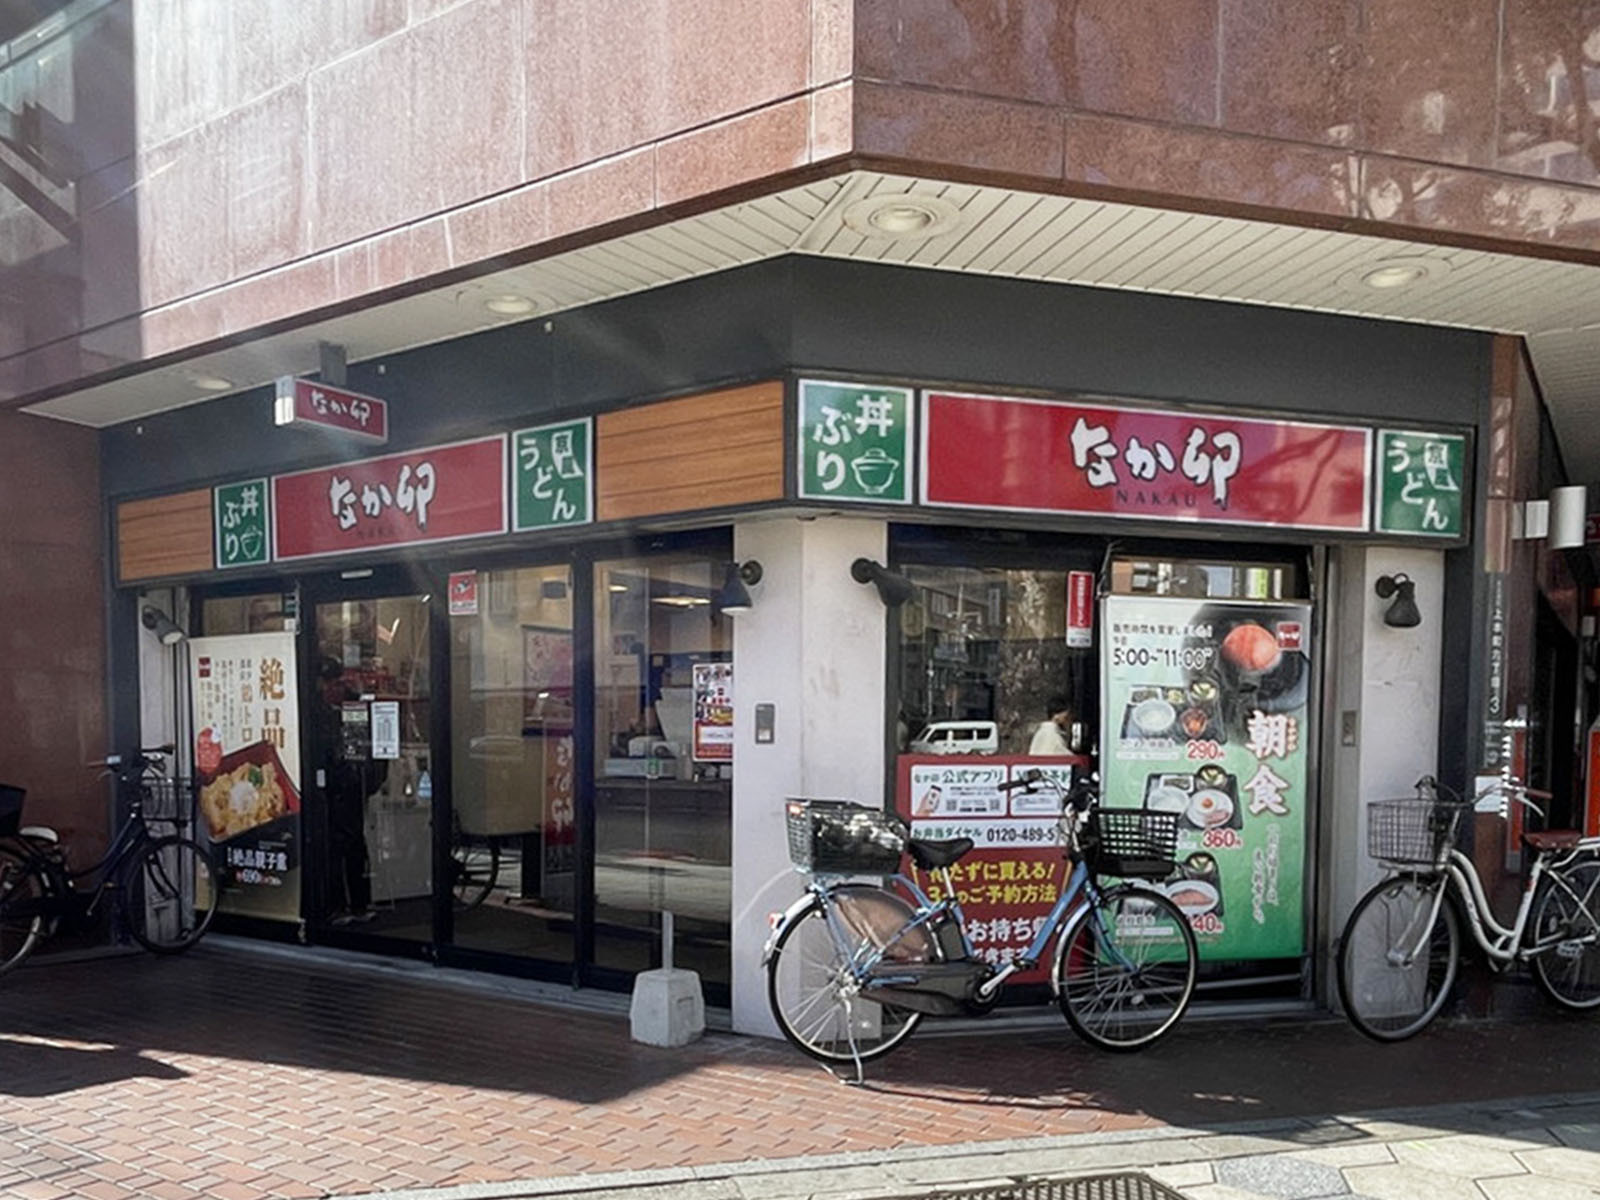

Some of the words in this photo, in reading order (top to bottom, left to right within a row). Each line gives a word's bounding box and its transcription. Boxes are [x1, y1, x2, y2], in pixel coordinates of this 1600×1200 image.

[310, 388, 371, 427] なか卯
[329, 461, 437, 532] なか卯
[519, 438, 577, 522] うどん
[1070, 416, 1242, 510] なか卯
[1116, 489, 1197, 507] NAKAU
[1387, 439, 1449, 531] うどん
[1243, 709, 1290, 815] 朝食
